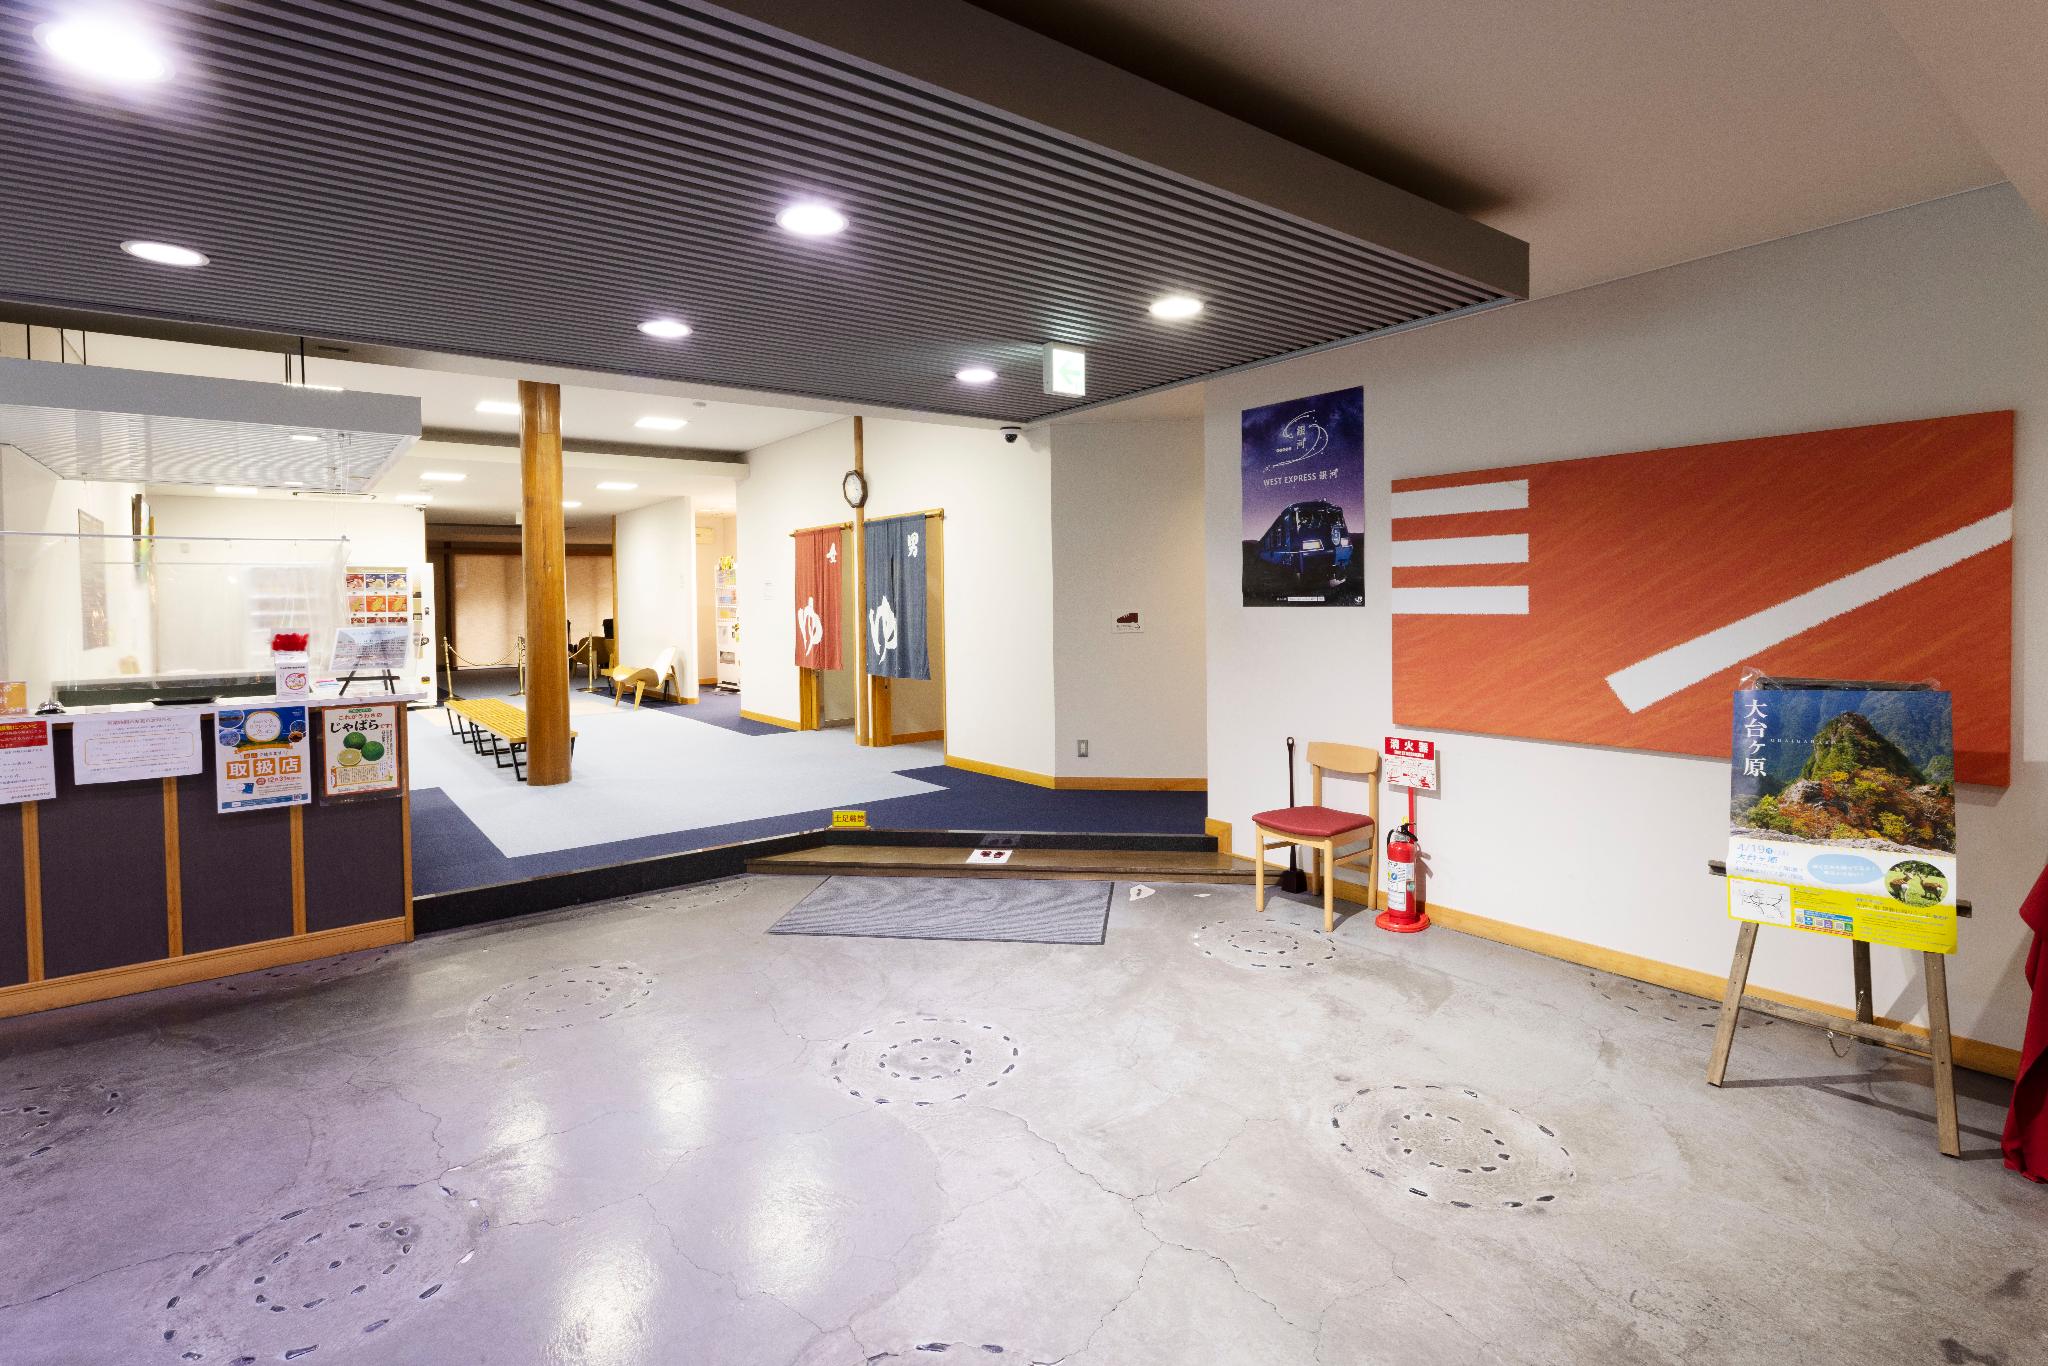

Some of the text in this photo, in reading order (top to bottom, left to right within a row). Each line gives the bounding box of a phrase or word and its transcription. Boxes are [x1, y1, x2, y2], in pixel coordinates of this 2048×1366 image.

[1263, 478, 1282, 487] WEST
[1284, 473, 1317, 484] EXPRESS
[907, 531, 919, 558] 男
[797, 596, 823, 657] ゆ
[869, 595, 898, 665] ゆ
[1389, 738, 1429, 754] 消火器
[229, 758, 299, 776] 取扱店
